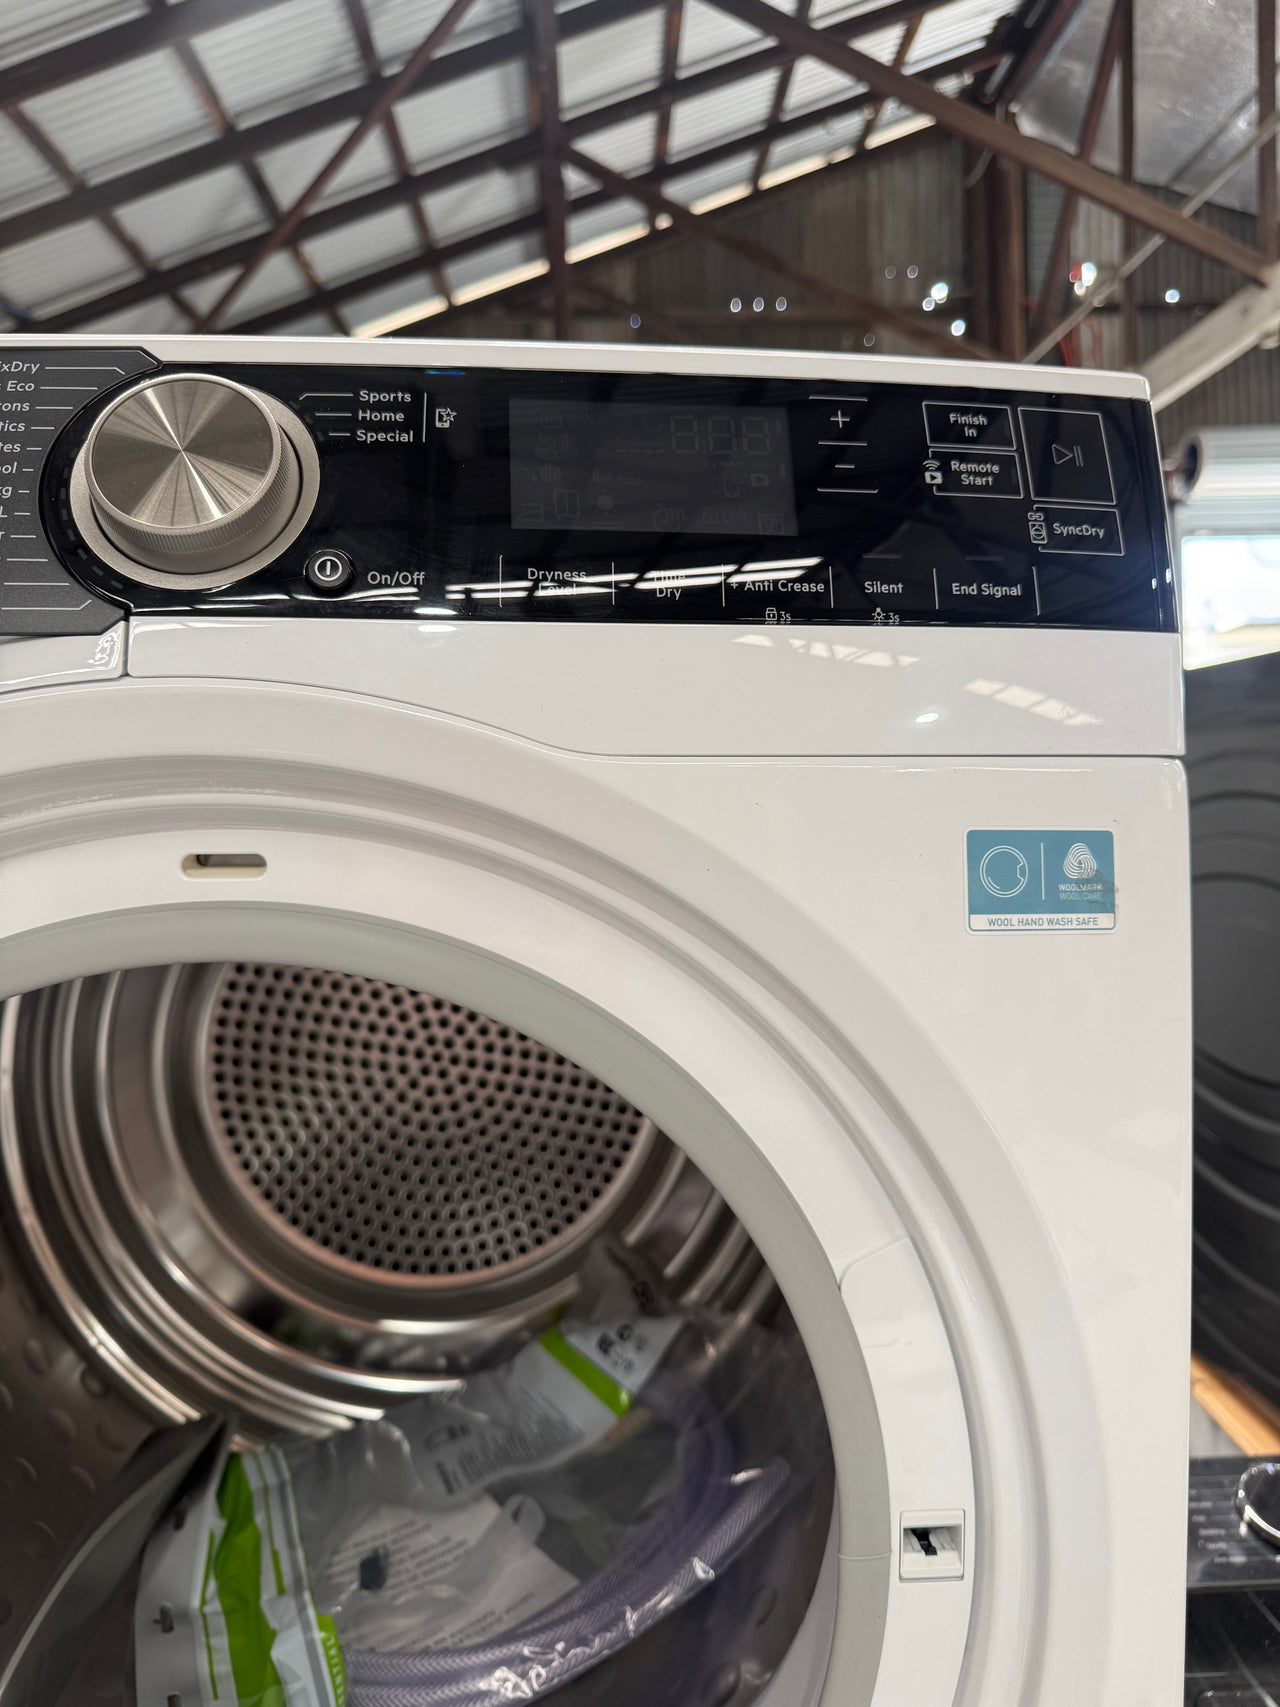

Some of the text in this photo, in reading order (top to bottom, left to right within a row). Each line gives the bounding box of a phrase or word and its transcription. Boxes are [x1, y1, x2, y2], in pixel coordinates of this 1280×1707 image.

[0, 361, 40, 374] xDry
[7, 380, 35, 391] Eco
[359, 390, 412, 404] Sports
[358, 409, 405, 422] Home
[949, 414, 988, 426] Finish
[356, 430, 414, 443] Special
[964, 427, 977, 438] In
[0, 461, 18, 474] ol
[950, 461, 1000, 474] Remote
[961, 474, 993, 486] Start
[1052, 523, 1105, 539] SyncDry
[367, 571, 426, 586] On/Off
[527, 567, 587, 584] Dryness
[744, 579, 773, 592] Anti
[778, 580, 825, 593] Crease
[864, 581, 903, 593] Silent
[951, 583, 1022, 598] End Signal
[656, 587, 682, 600] Dry
[779, 611, 791, 621] 3s
[888, 612, 900, 622] 3s
[987, 917, 1099, 927] WOOL HAND WASH SAFE
